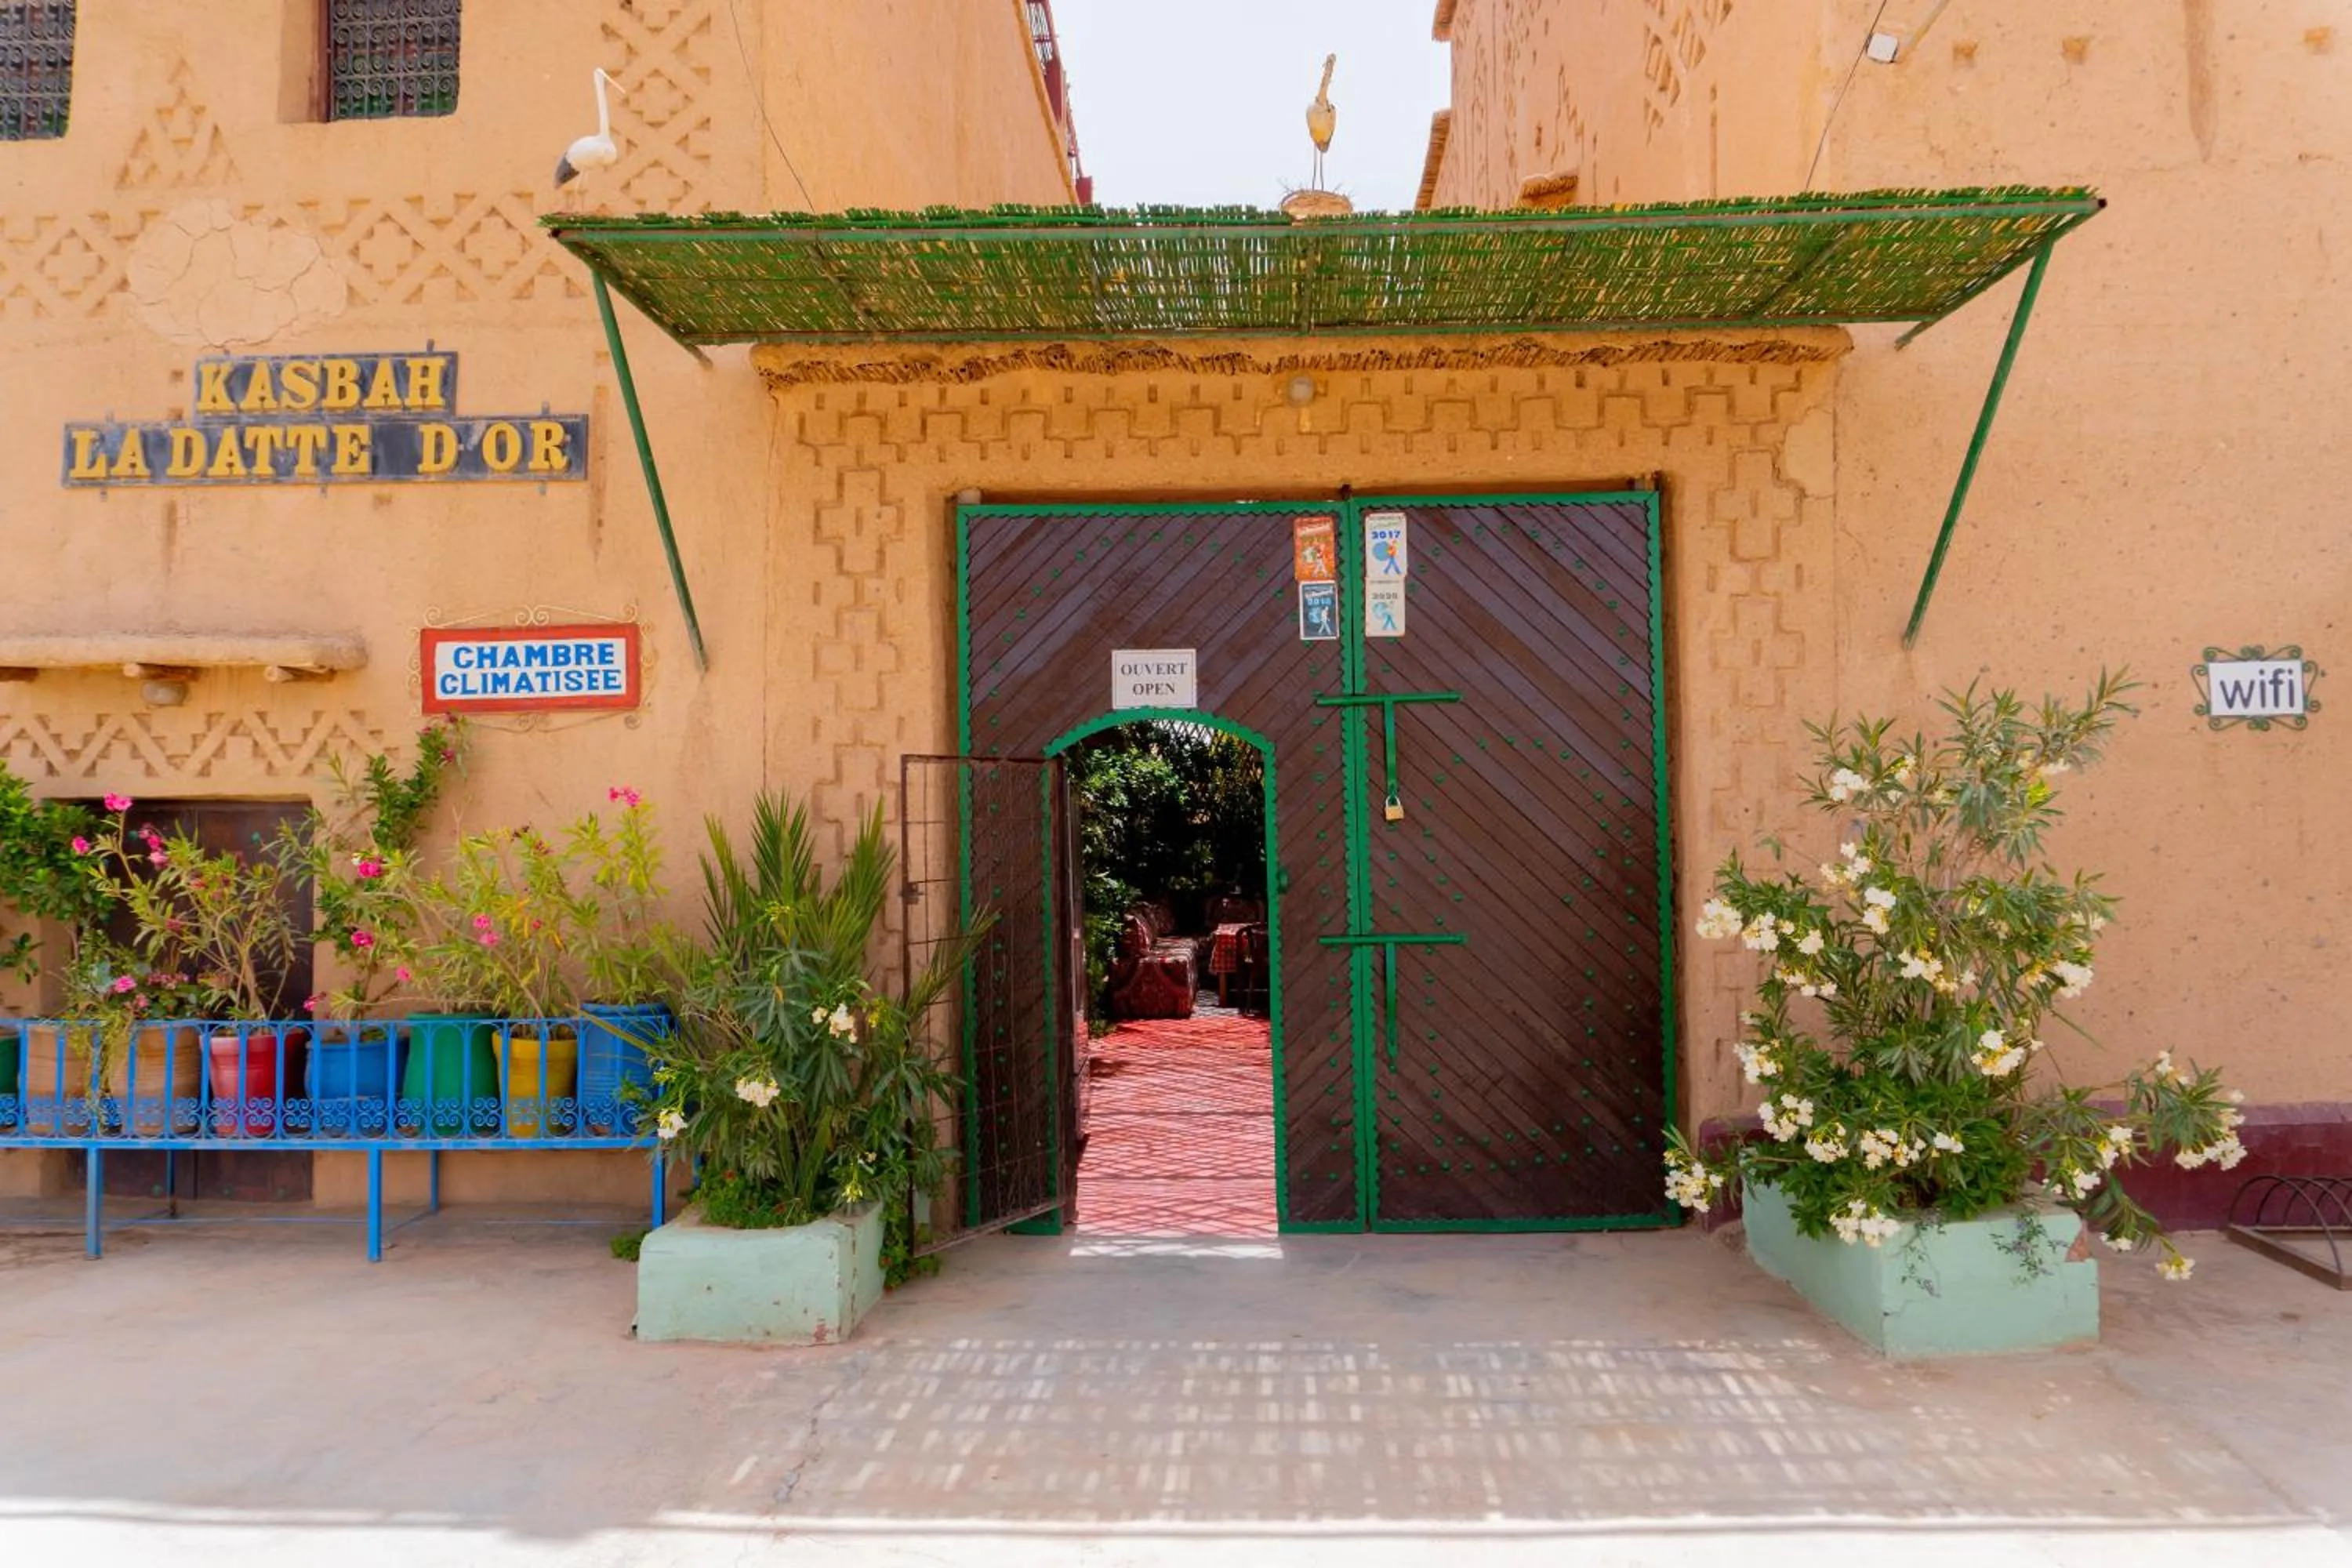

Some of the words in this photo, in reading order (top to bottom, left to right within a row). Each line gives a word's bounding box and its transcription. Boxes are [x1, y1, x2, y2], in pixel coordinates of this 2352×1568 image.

[197, 357, 448, 412] KASBAH
[69, 426, 151, 478] LA
[165, 423, 372, 477] DATTE
[453, 643, 615, 669] CHAMBRE
[1120, 662, 1188, 675] OUVERT
[439, 669, 622, 695] CLIMATISEE
[1132, 683, 1175, 695] OPEN
[2220, 669, 2295, 710] wifi
